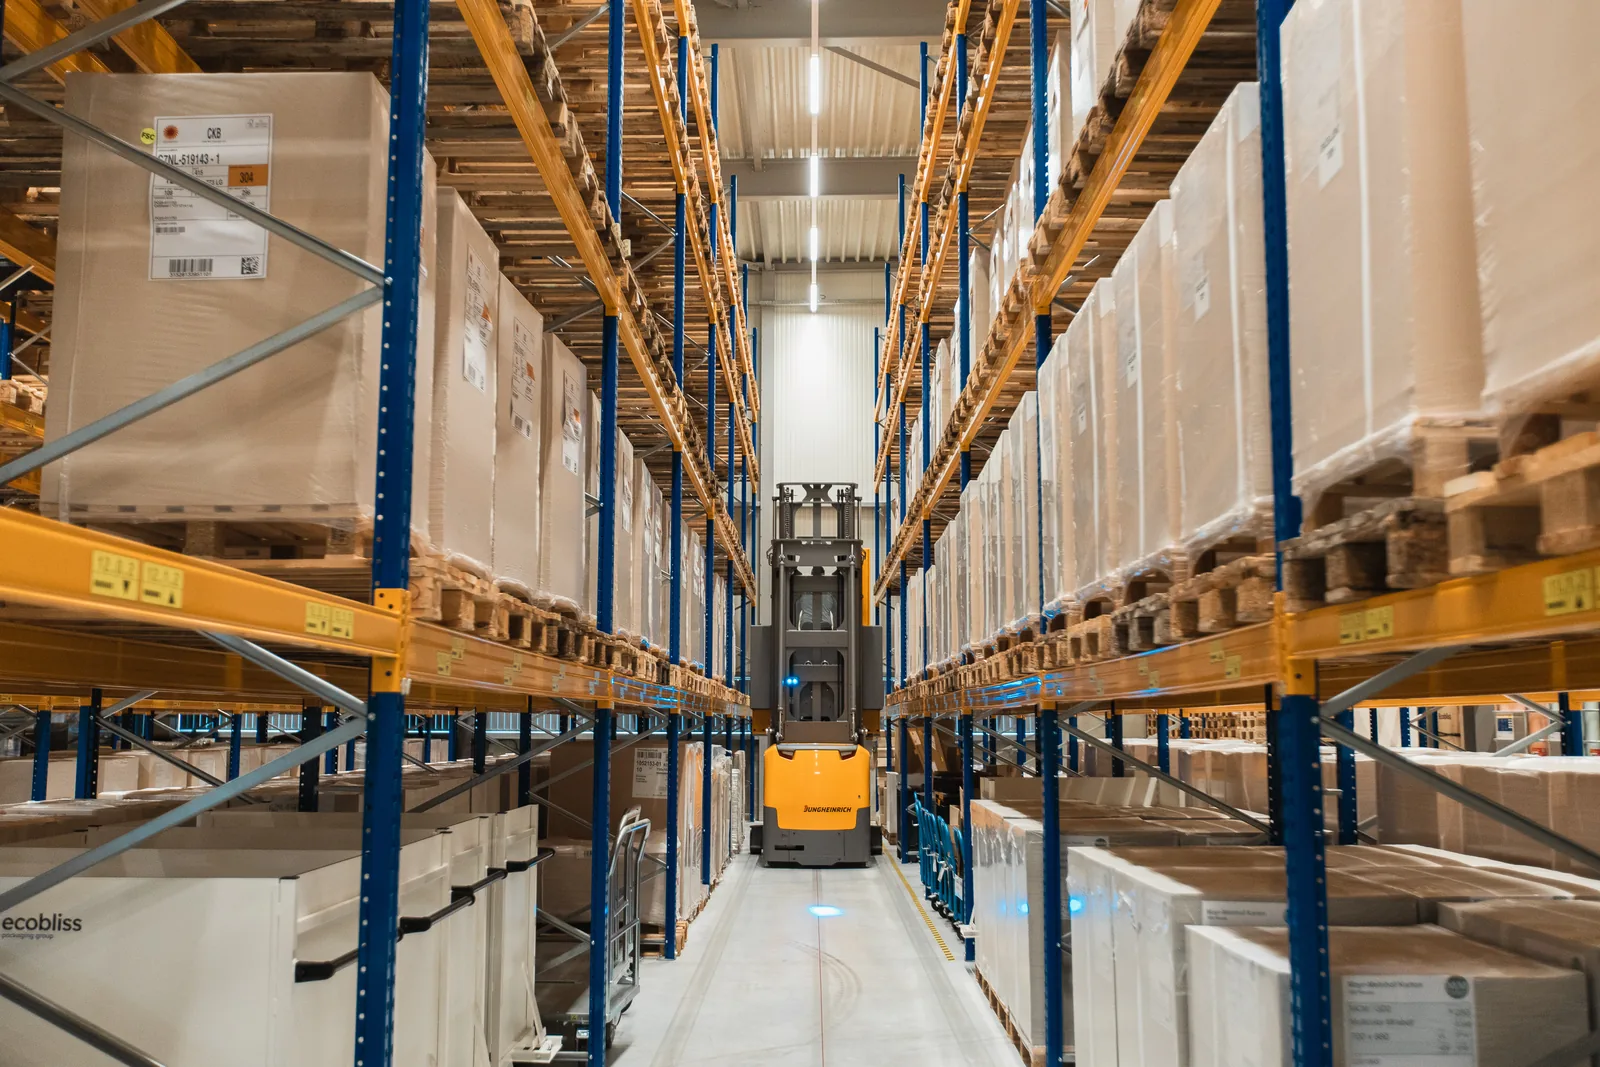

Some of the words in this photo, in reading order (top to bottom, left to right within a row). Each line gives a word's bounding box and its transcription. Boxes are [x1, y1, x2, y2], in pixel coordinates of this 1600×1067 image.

[141, 132, 156, 141] FSC
[207, 128, 221, 139] CKB
[239, 172, 254, 184] 304
[803, 805, 852, 813] JUNGHEINRICH
[2, 913, 82, 931] ecobliss
